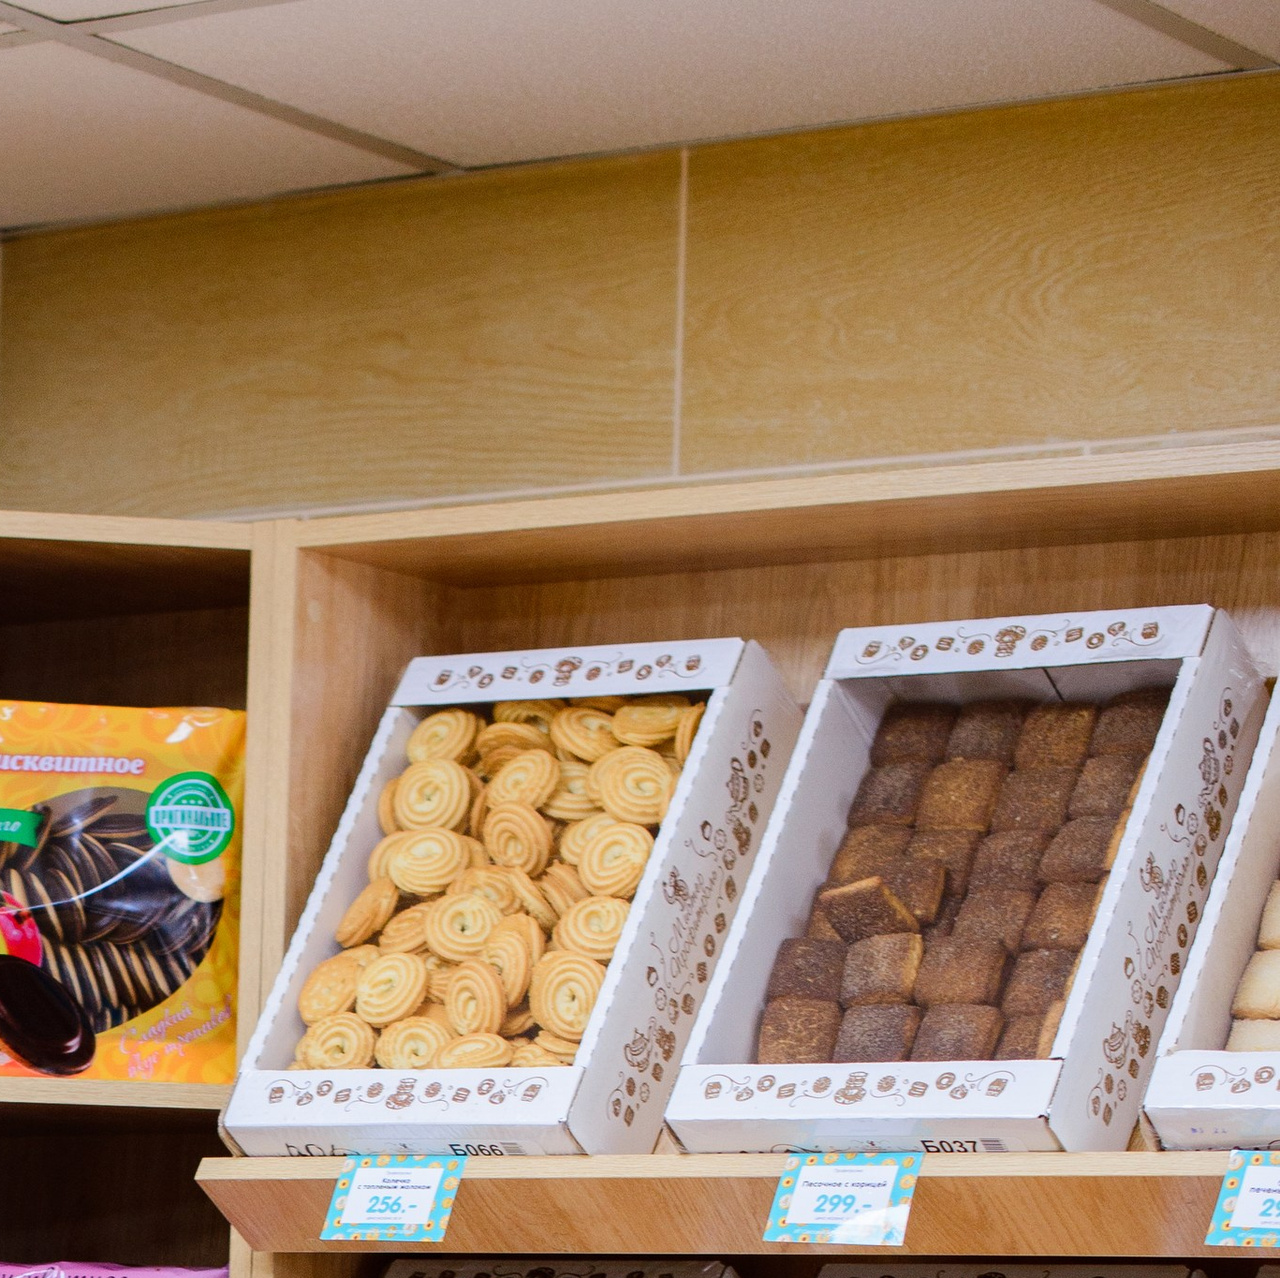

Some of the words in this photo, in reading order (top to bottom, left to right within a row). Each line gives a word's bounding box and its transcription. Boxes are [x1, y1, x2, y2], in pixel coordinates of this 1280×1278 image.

[448, 1143, 504, 1156] Б066
[921, 1140, 978, 1153] Б037
[802, 1180, 842, 1188] Песочное
[366, 1196, 417, 1213] 256.-
[813, 1194, 872, 1213] 299.-
